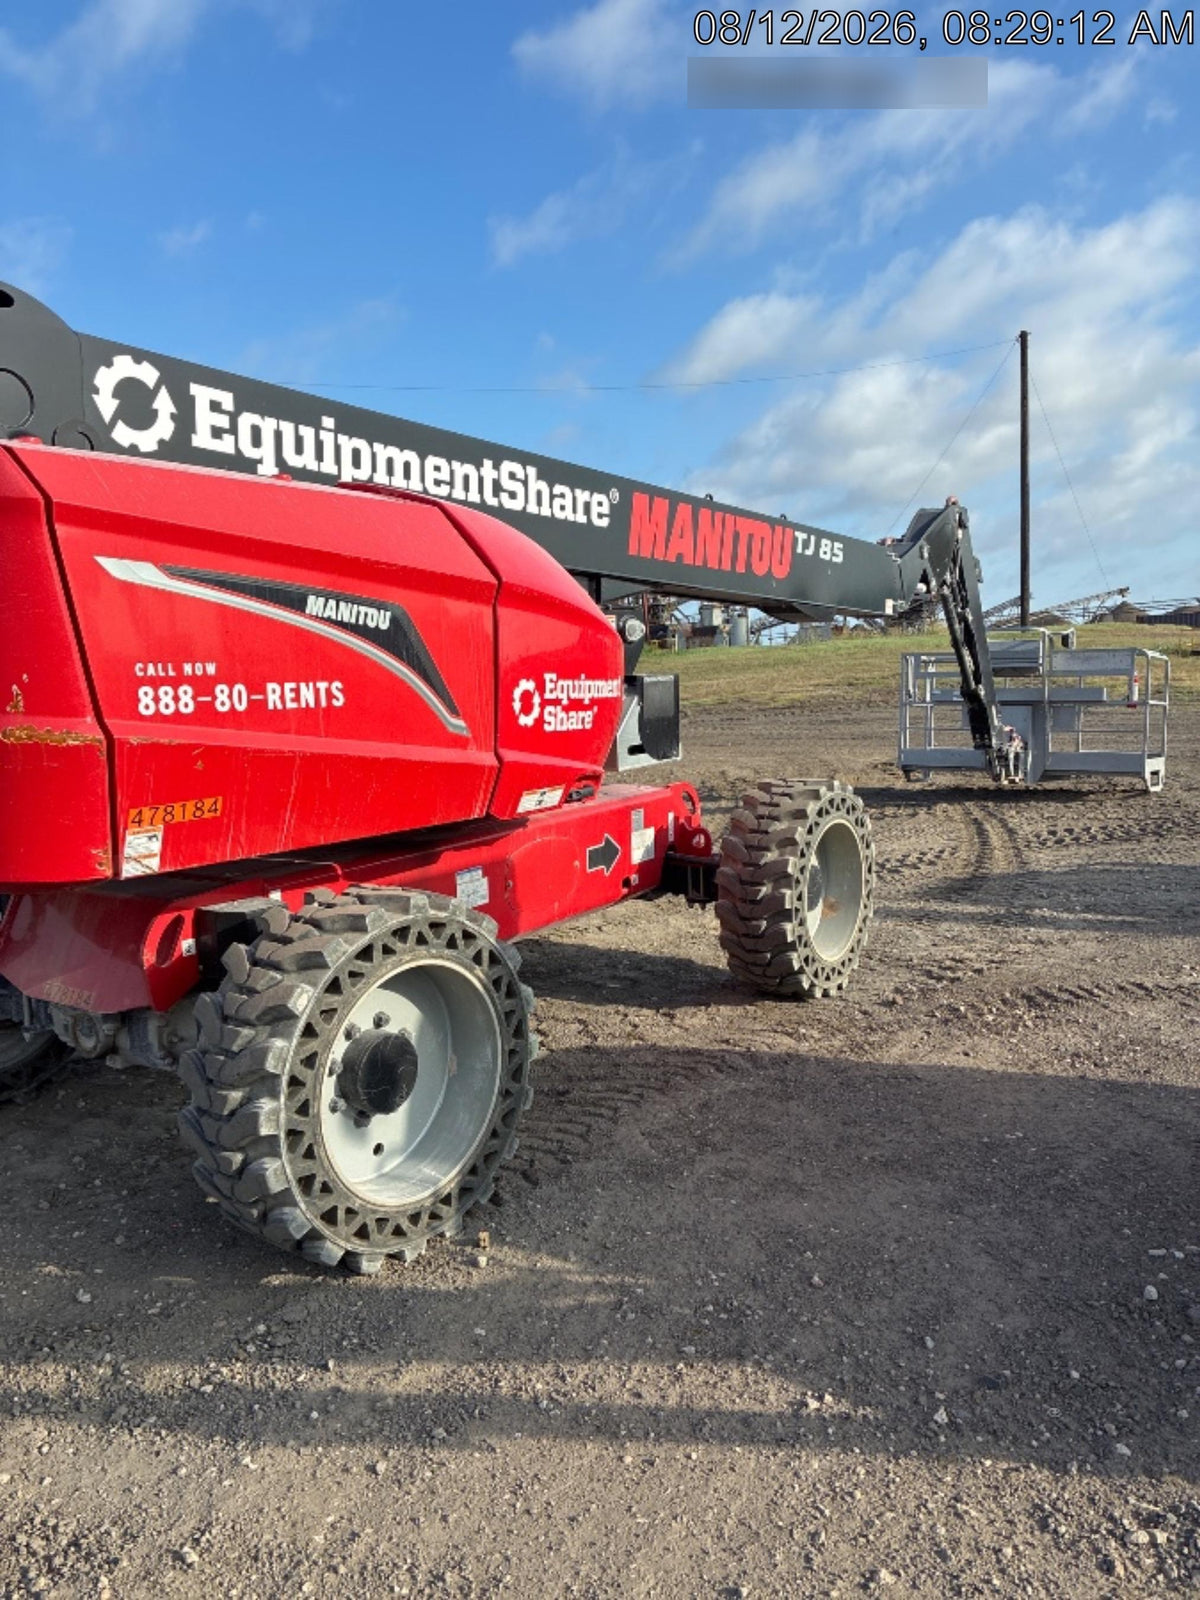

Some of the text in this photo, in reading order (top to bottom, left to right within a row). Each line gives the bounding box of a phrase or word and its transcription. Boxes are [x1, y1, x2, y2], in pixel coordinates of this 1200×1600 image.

[628, 491, 844, 580] MANITOU TJ 85
[305, 595, 392, 630] MANITOU
[134, 662, 217, 677] CALL NOW
[137, 681, 345, 716] 888-80-RENTS
[131, 798, 219, 827] 478184
